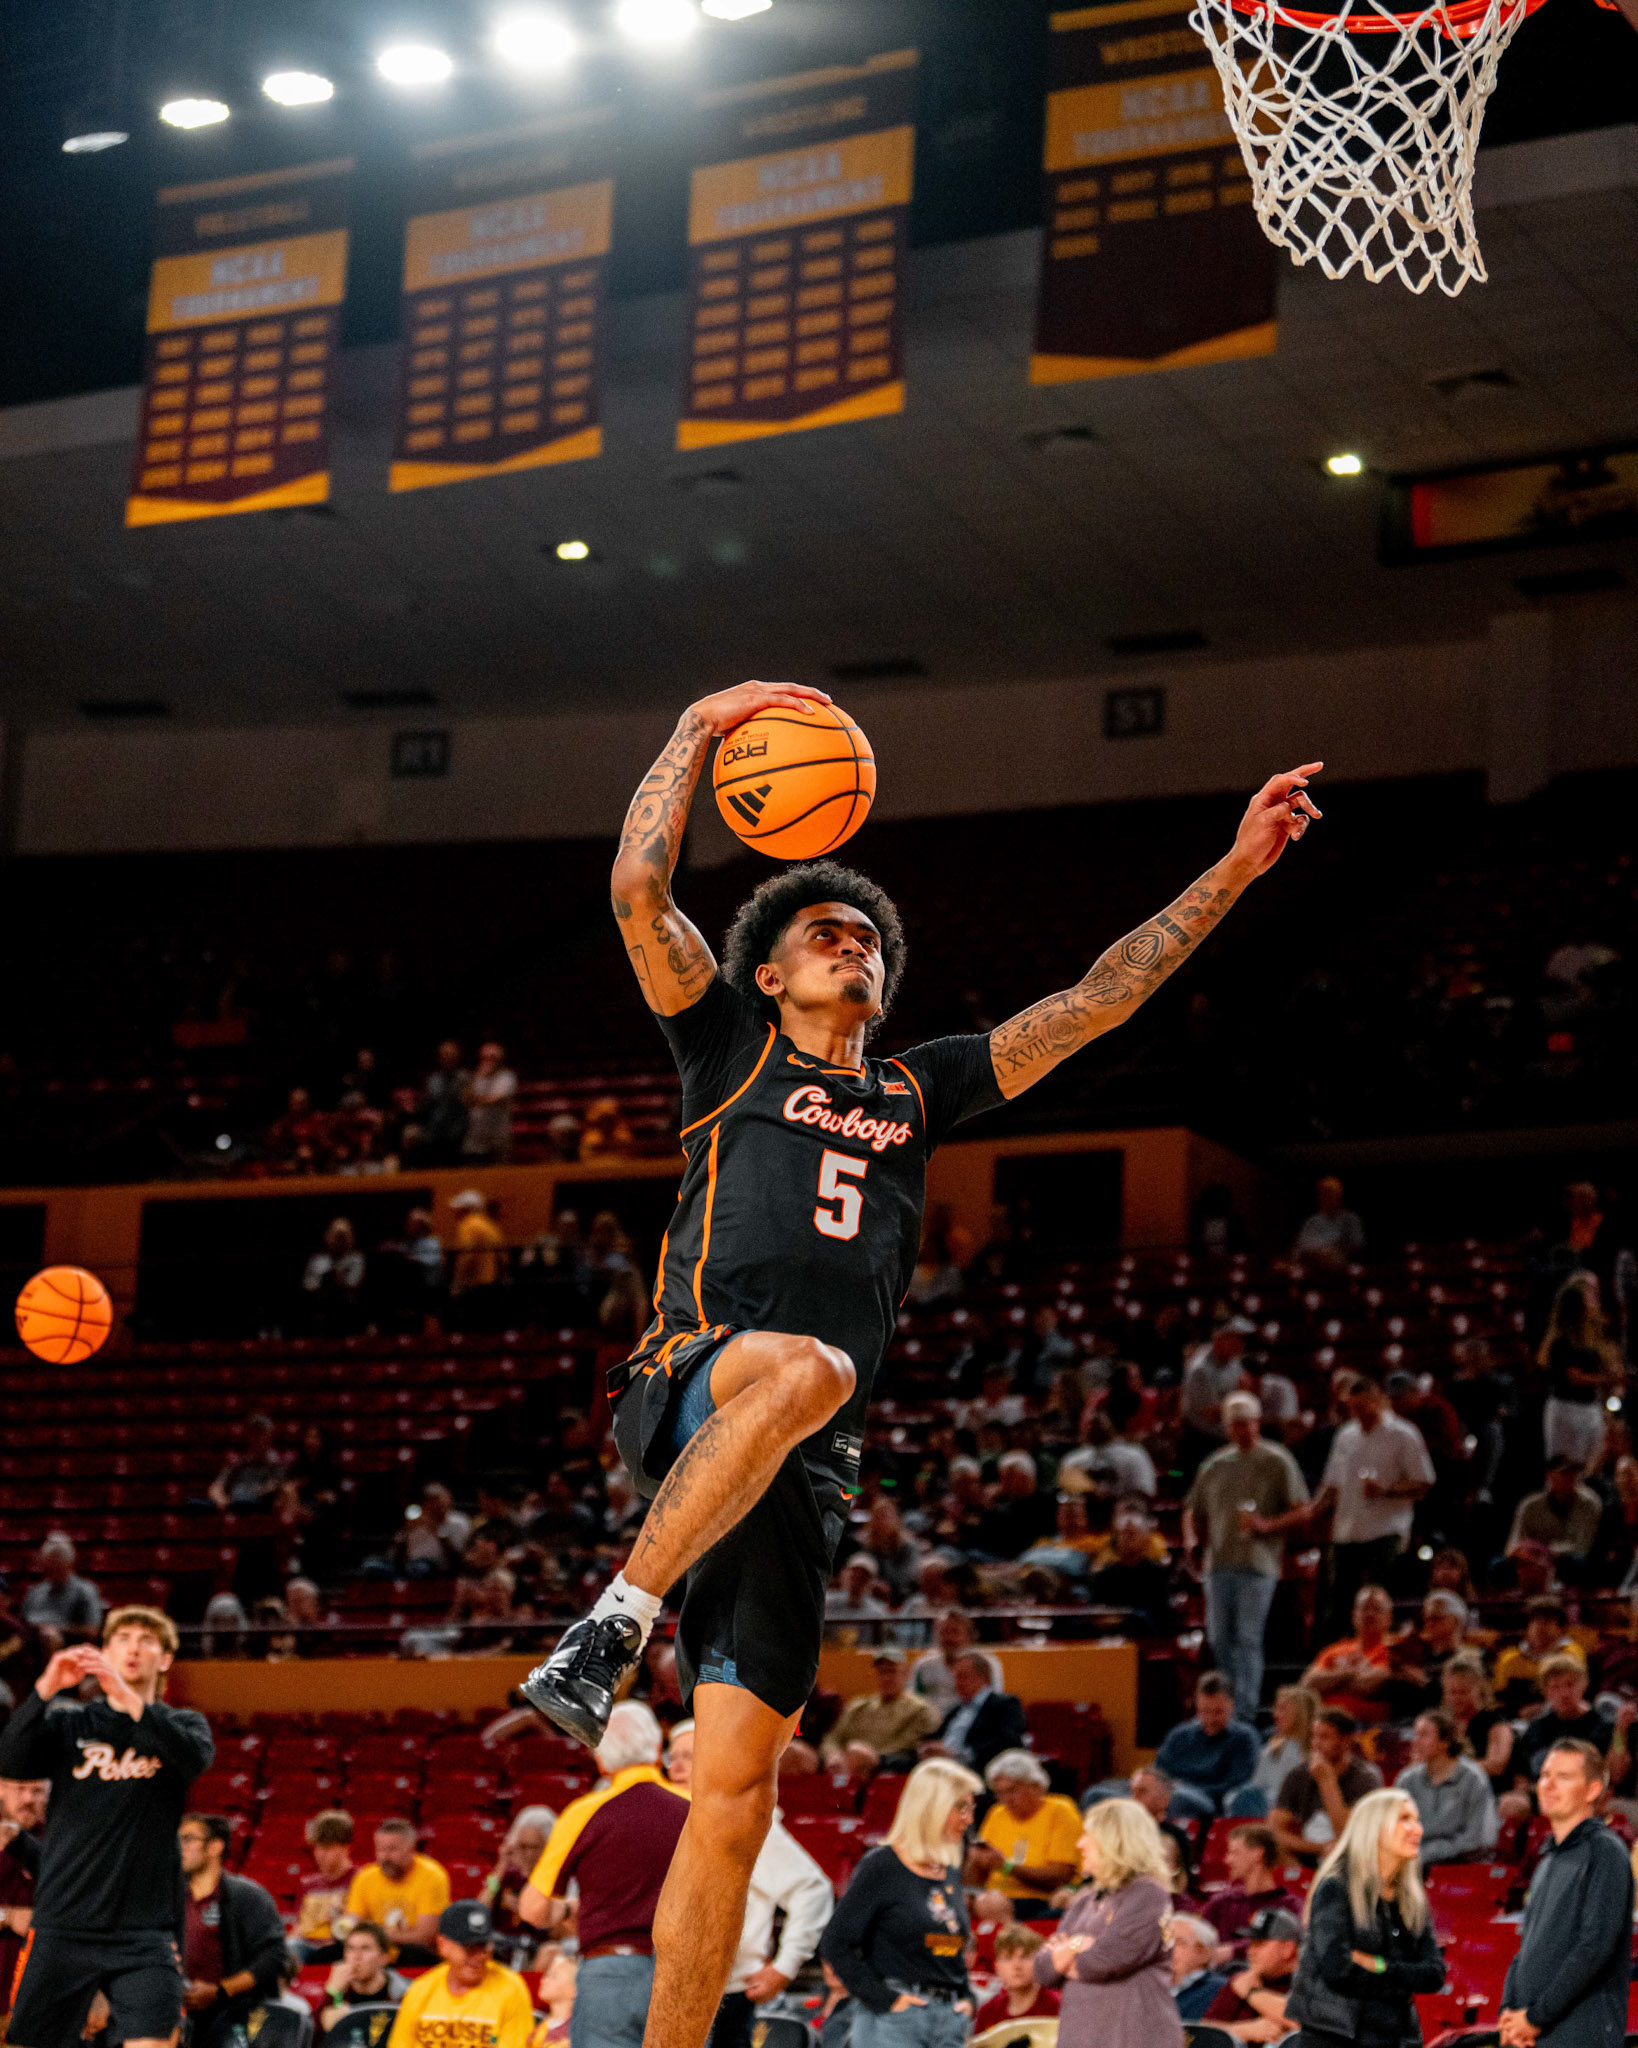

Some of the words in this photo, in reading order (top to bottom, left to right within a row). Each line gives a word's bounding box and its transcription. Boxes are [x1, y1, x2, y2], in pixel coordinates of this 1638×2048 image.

[723, 740, 768, 766] PRO
[783, 1084, 913, 1152] Cowboys
[813, 1148, 869, 1241] 5
